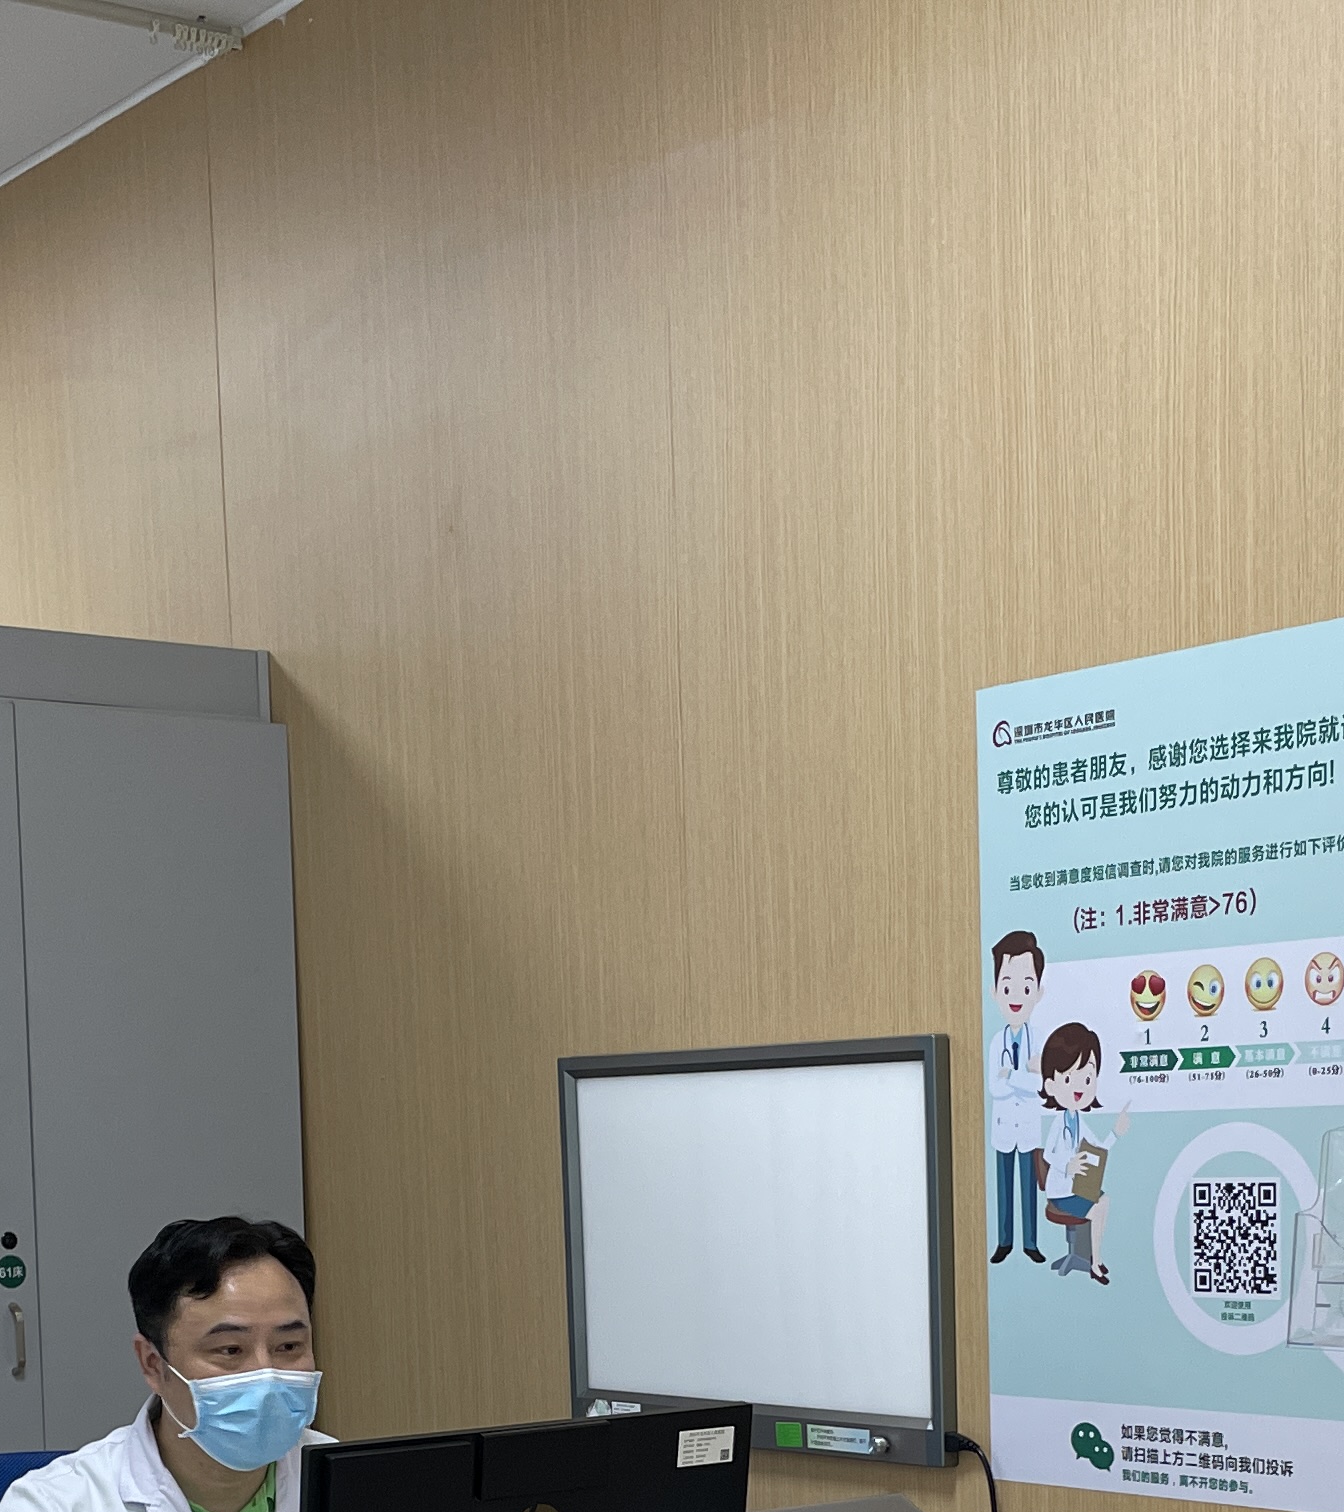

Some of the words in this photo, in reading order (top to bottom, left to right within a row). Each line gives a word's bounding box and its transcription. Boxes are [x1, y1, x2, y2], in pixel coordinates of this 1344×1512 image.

[1200, 1024, 1210, 1042] 2
[1259, 1021, 1268, 1038] 3
[1321, 1017, 1331, 1034] 4
[1144, 1028, 1151, 1045] 1
